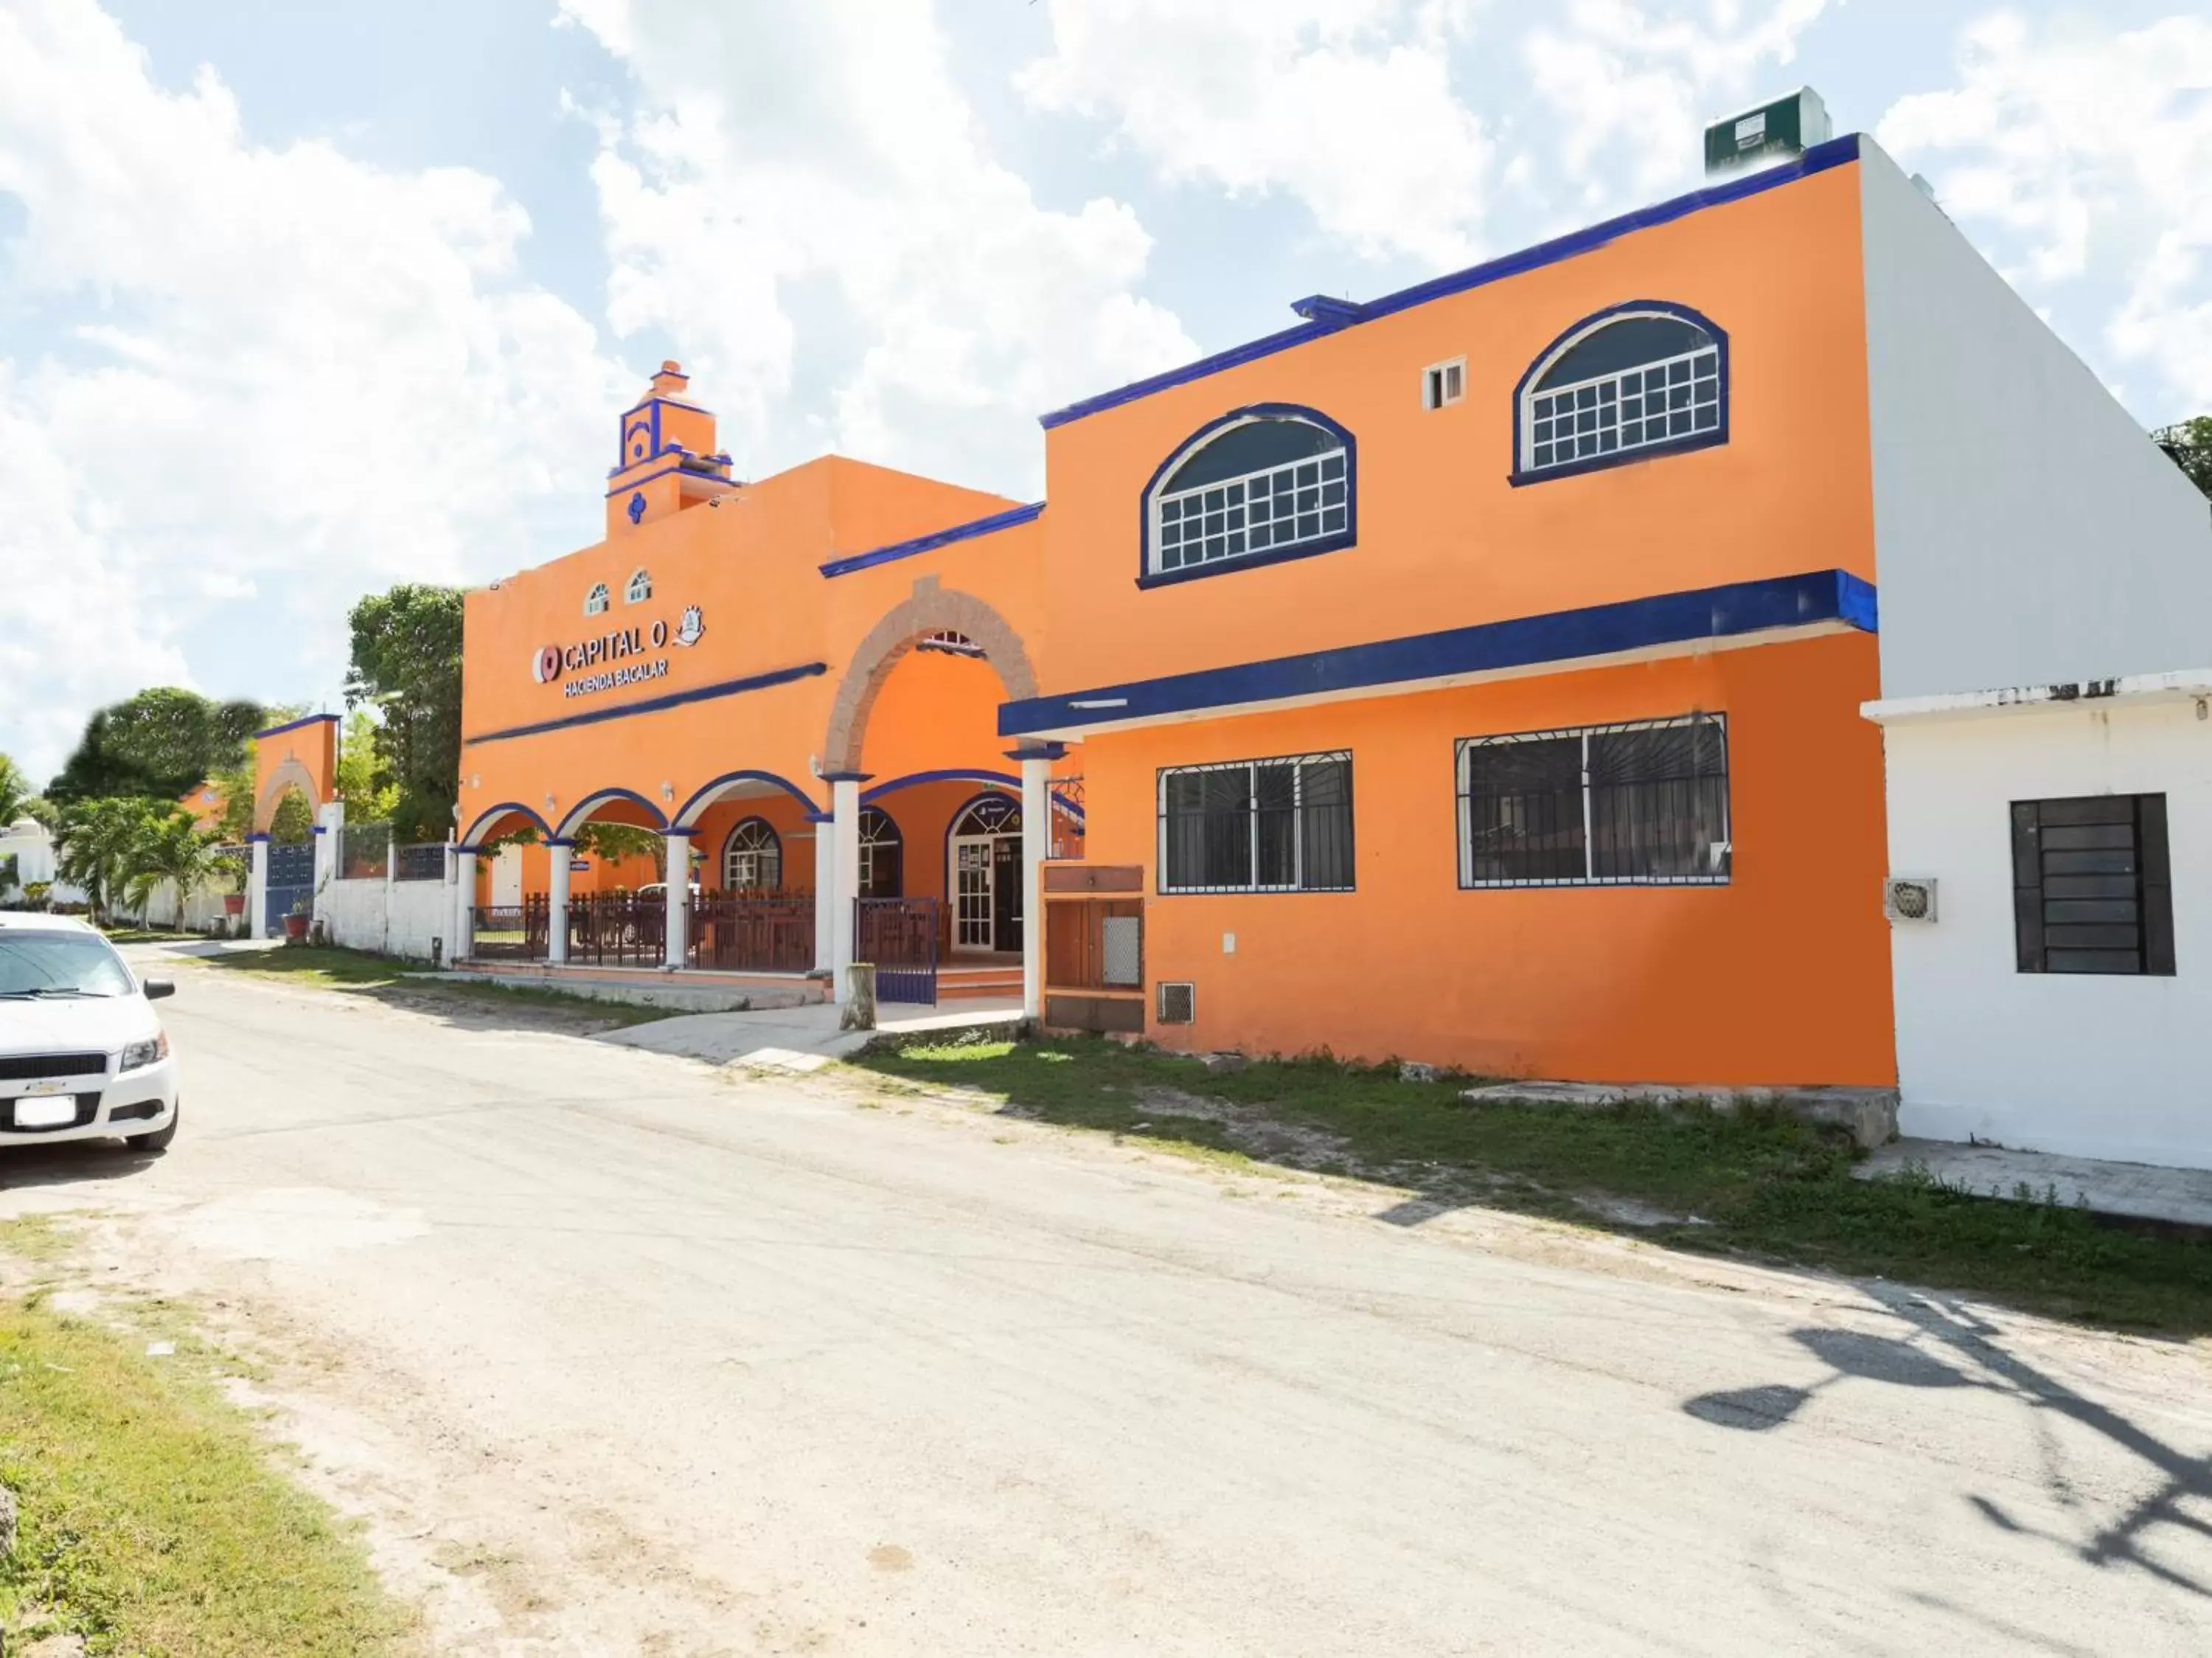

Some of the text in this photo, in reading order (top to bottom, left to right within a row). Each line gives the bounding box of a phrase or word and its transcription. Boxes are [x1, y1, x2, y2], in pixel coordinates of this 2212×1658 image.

[565, 620, 667, 670] CAPITAL O
[564, 659, 668, 698] HACIENDA BACALAR
